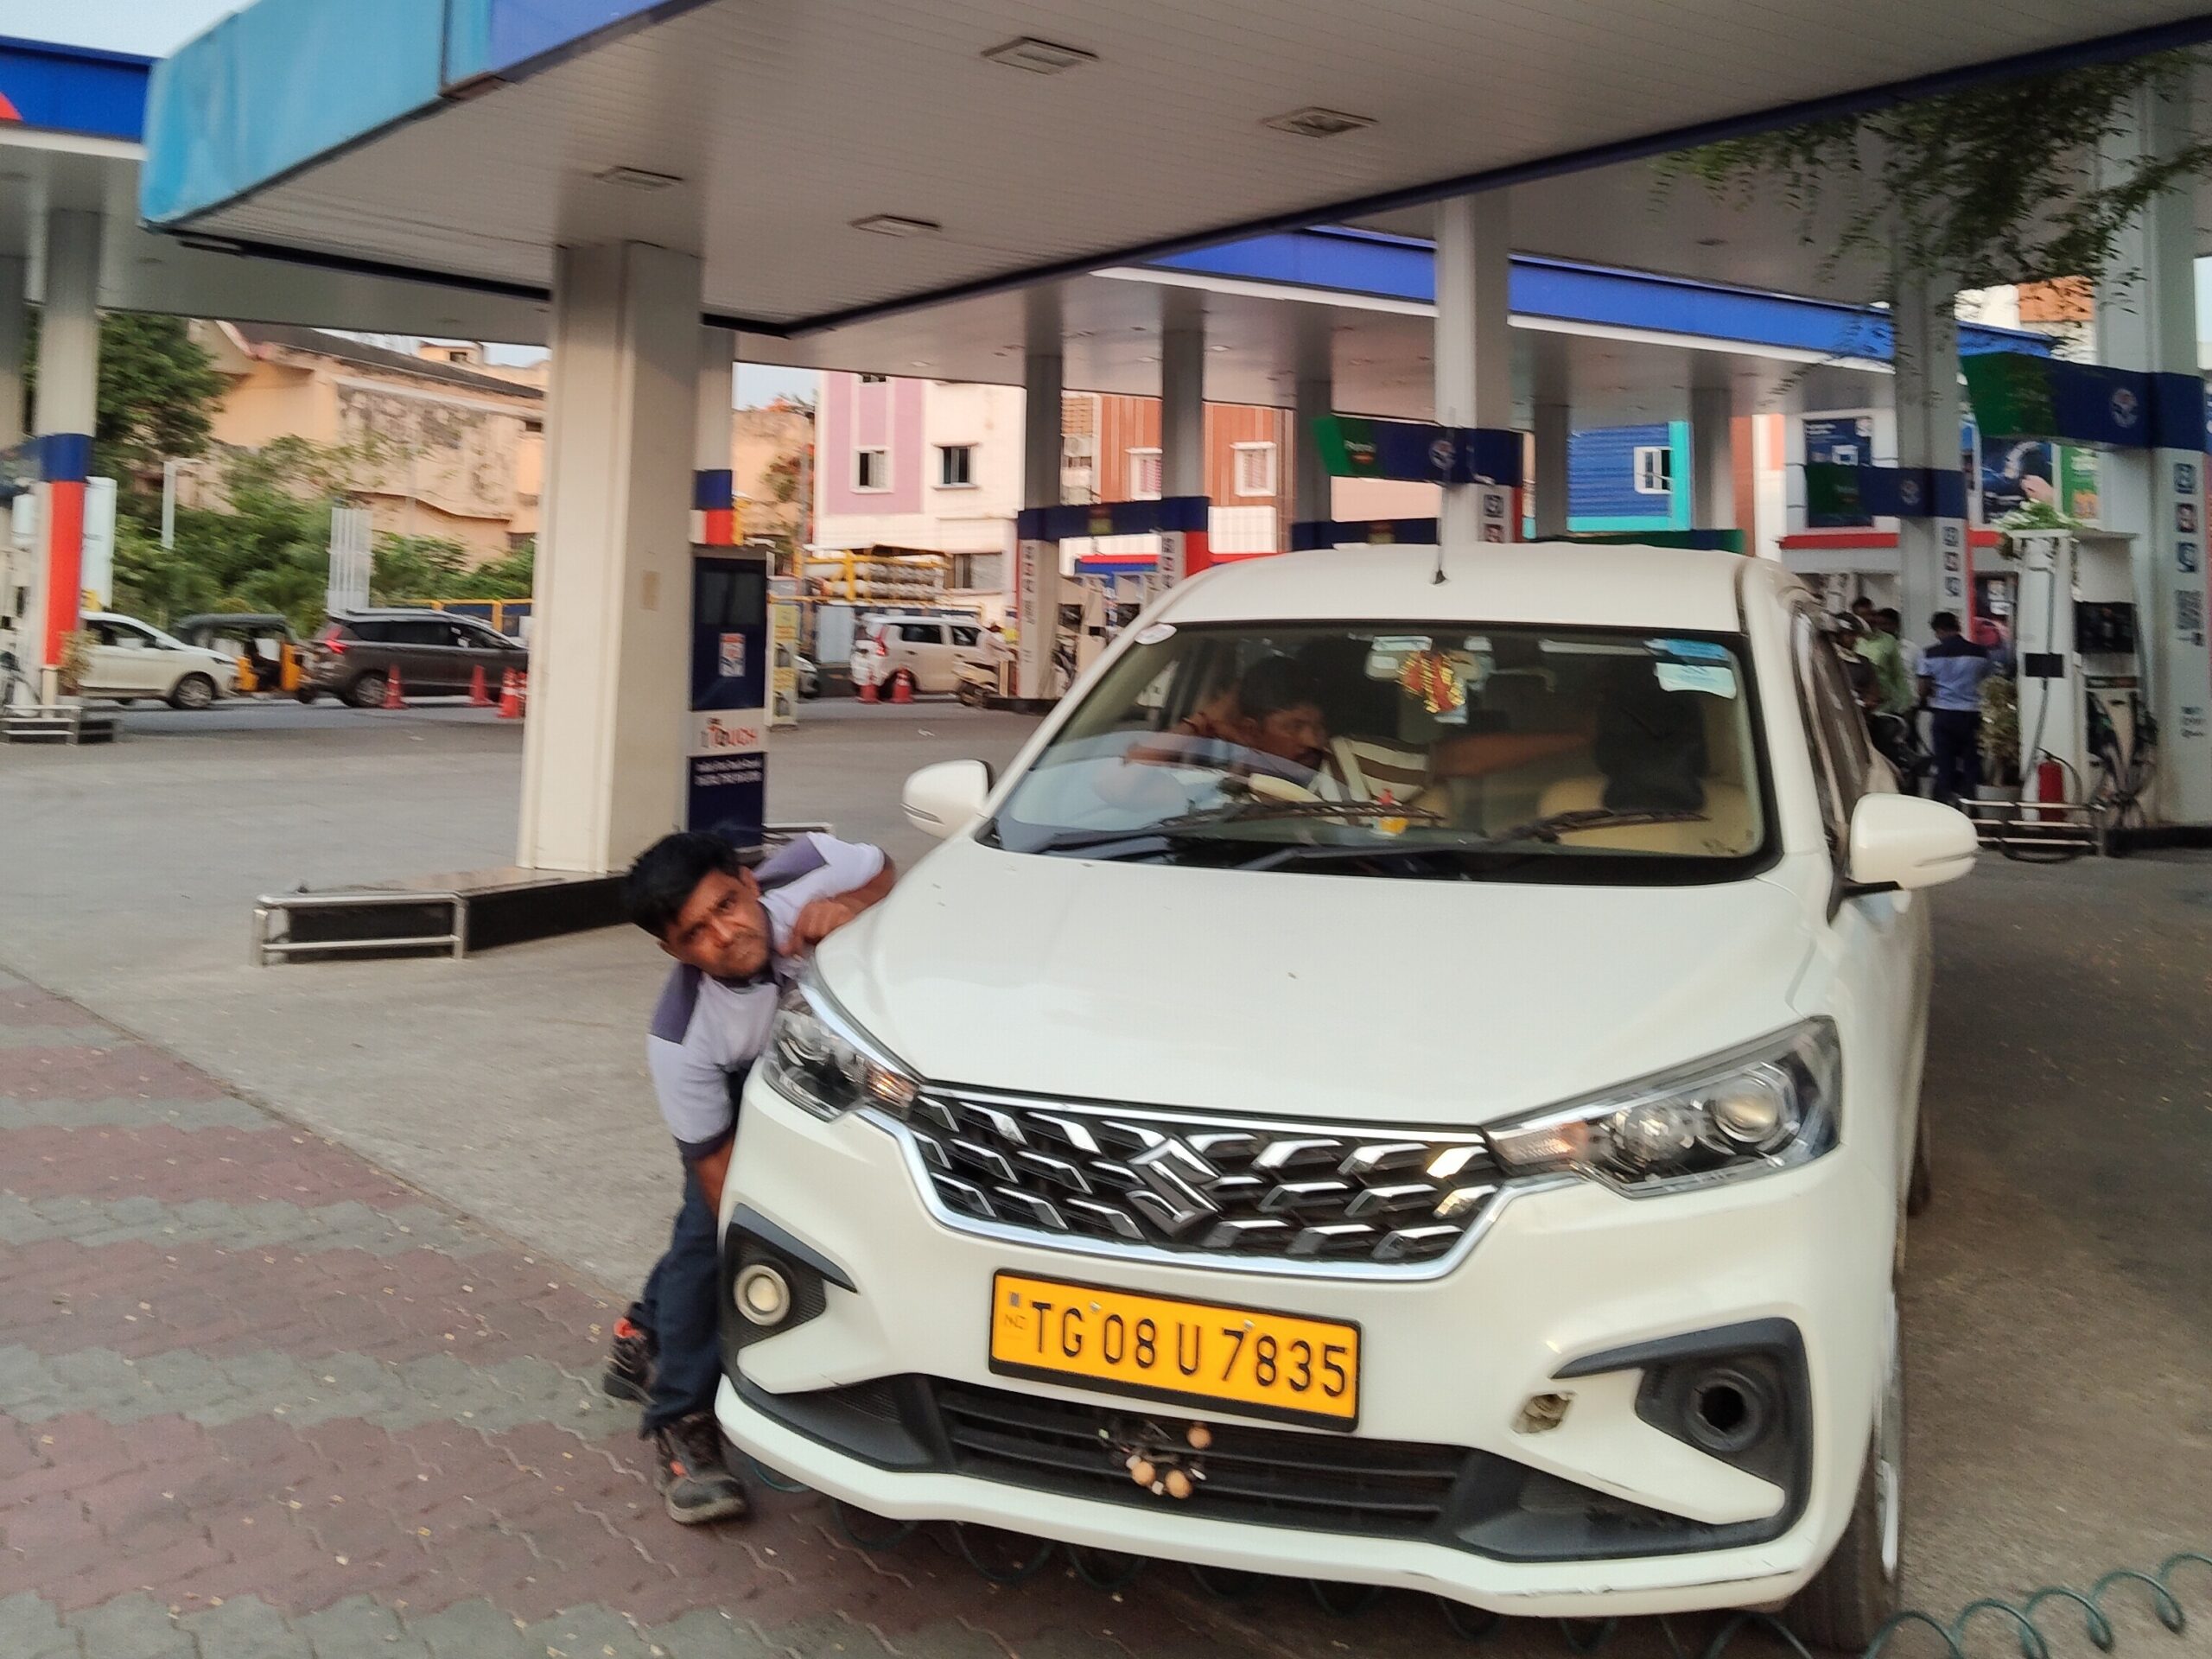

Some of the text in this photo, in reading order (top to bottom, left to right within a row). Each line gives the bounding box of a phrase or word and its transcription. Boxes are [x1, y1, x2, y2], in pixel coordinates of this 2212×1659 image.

[1032, 1301, 1347, 1397] TG 08 U 7835
